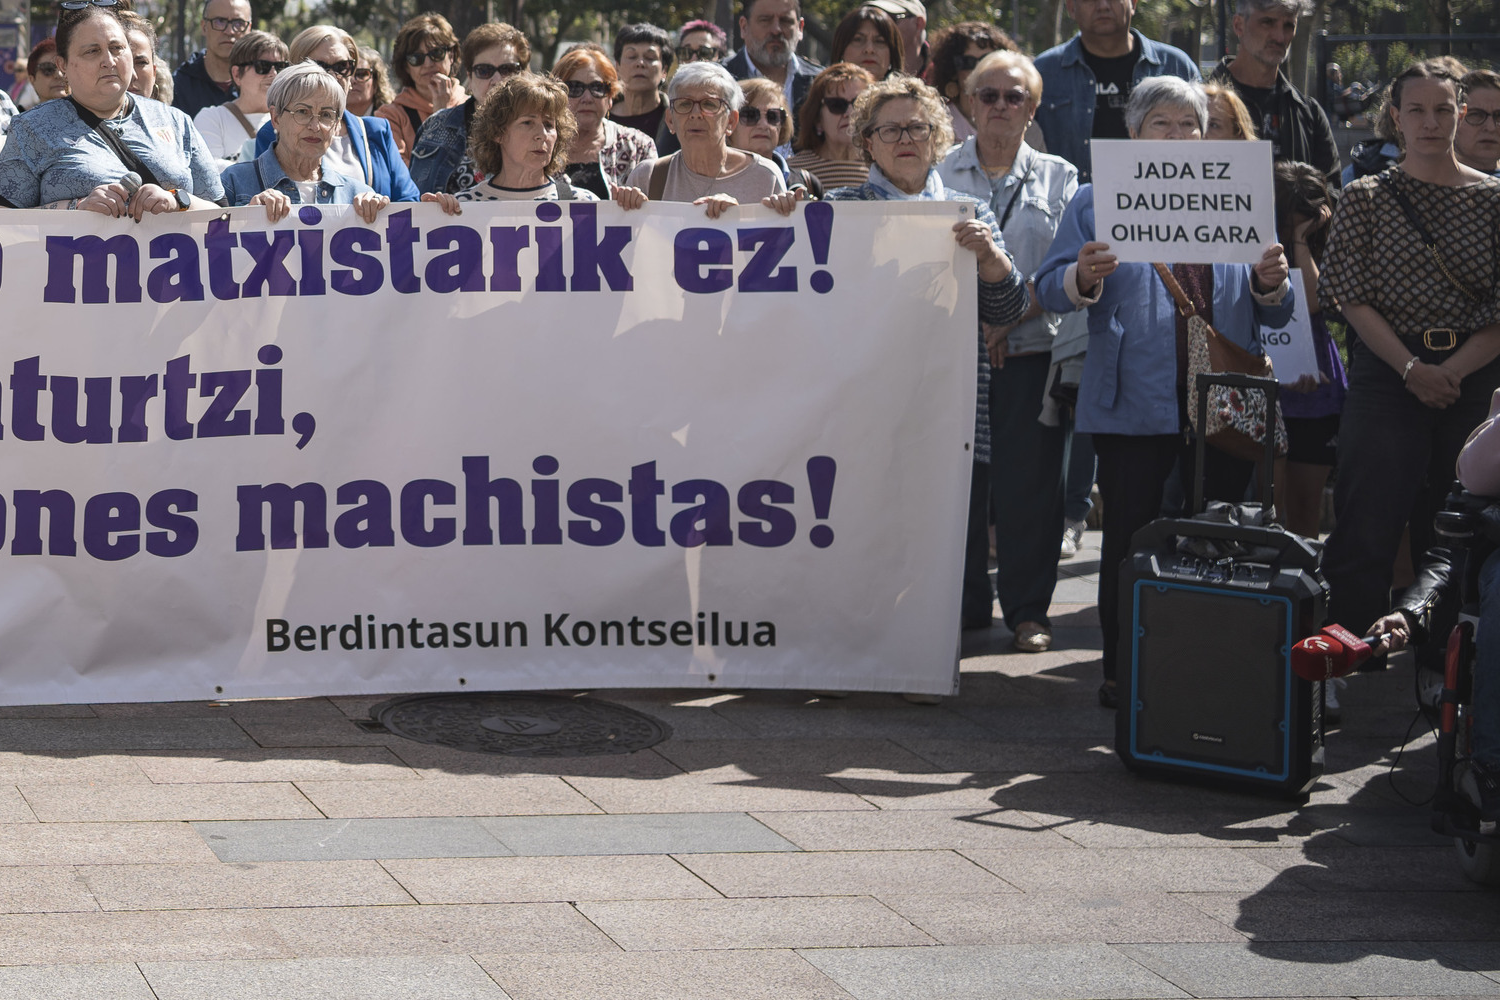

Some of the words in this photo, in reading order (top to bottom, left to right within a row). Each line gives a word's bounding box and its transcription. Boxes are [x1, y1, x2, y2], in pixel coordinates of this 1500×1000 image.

[1094, 82, 1119, 95] ILA
[1134, 162, 1196, 180] JADA
[1202, 162, 1231, 180] EZ
[1116, 193, 1252, 212] DAUDENEN
[1111, 224, 1189, 243] OIHUA
[1194, 225, 1261, 244] GARA
[43, 202, 634, 304] matxistarik
[673, 201, 835, 295] ez!
[235, 454, 837, 553] machistas!
[266, 614, 529, 653] Berdintasun
[544, 611, 778, 649] Kontseilua
